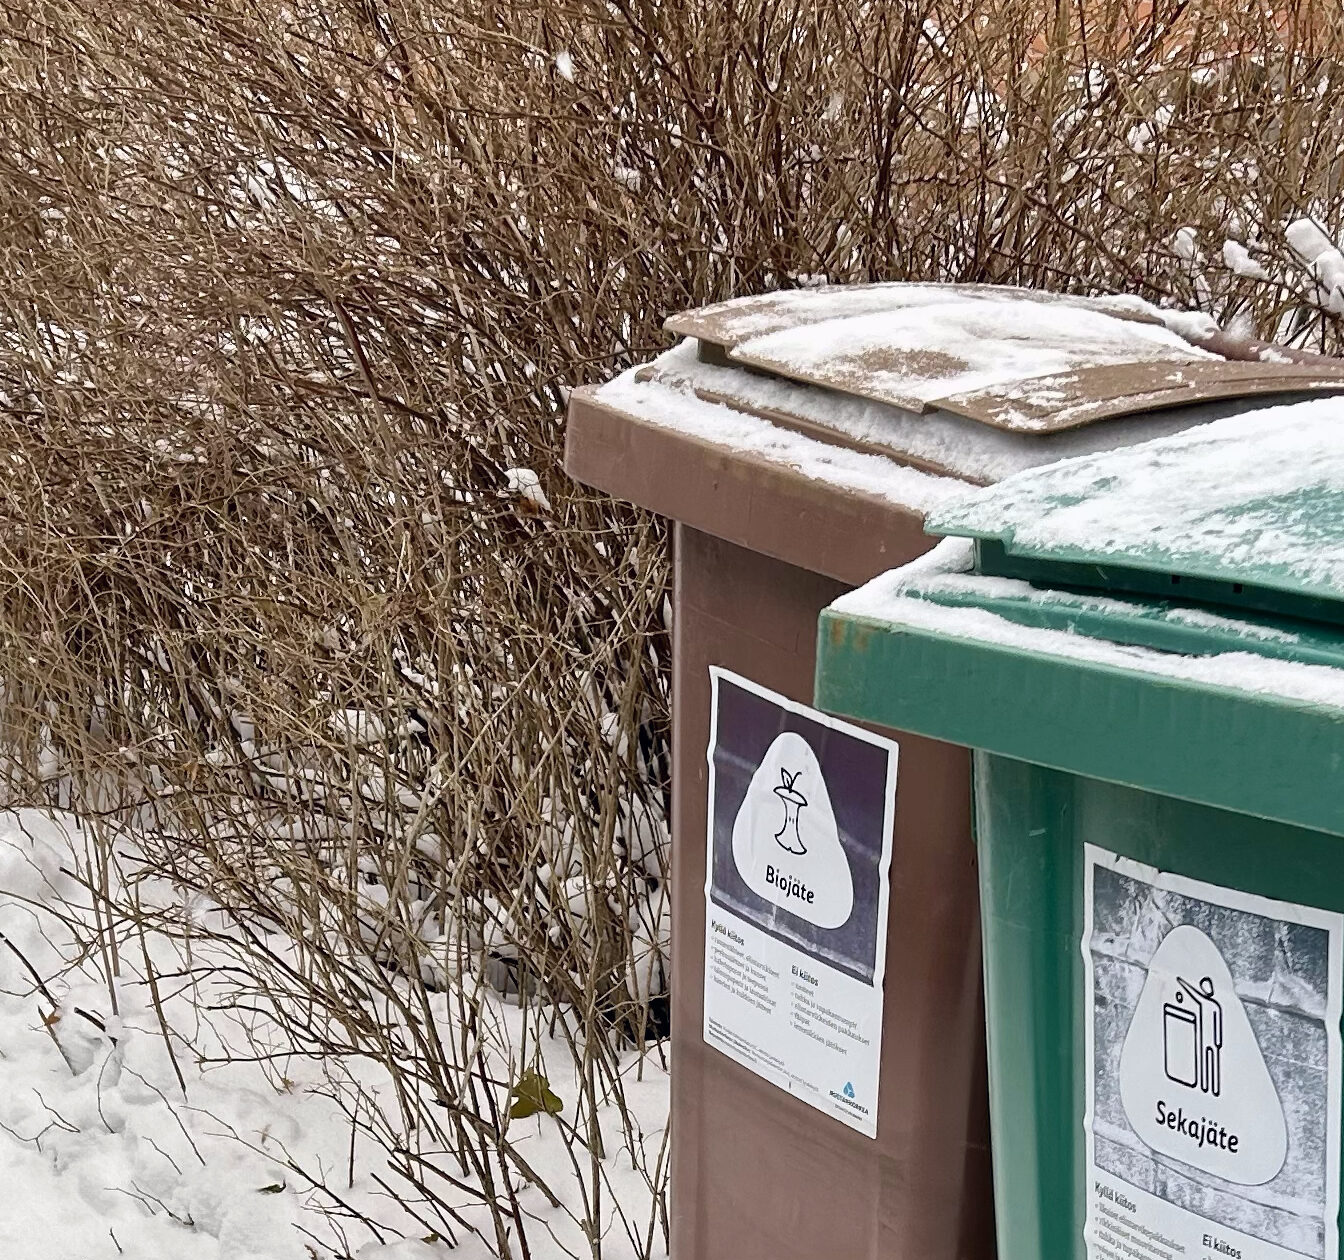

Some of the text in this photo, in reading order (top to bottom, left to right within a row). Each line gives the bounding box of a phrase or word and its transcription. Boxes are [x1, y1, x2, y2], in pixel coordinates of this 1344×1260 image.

[766, 864, 814, 904] Biojäte
[799, 968, 819, 986] kiitos
[1156, 1100, 1239, 1153] Sekajäte
[1095, 1181, 1136, 1213] Kyllä kiitos
[1202, 1234, 1242, 1260] Ei kiitos
